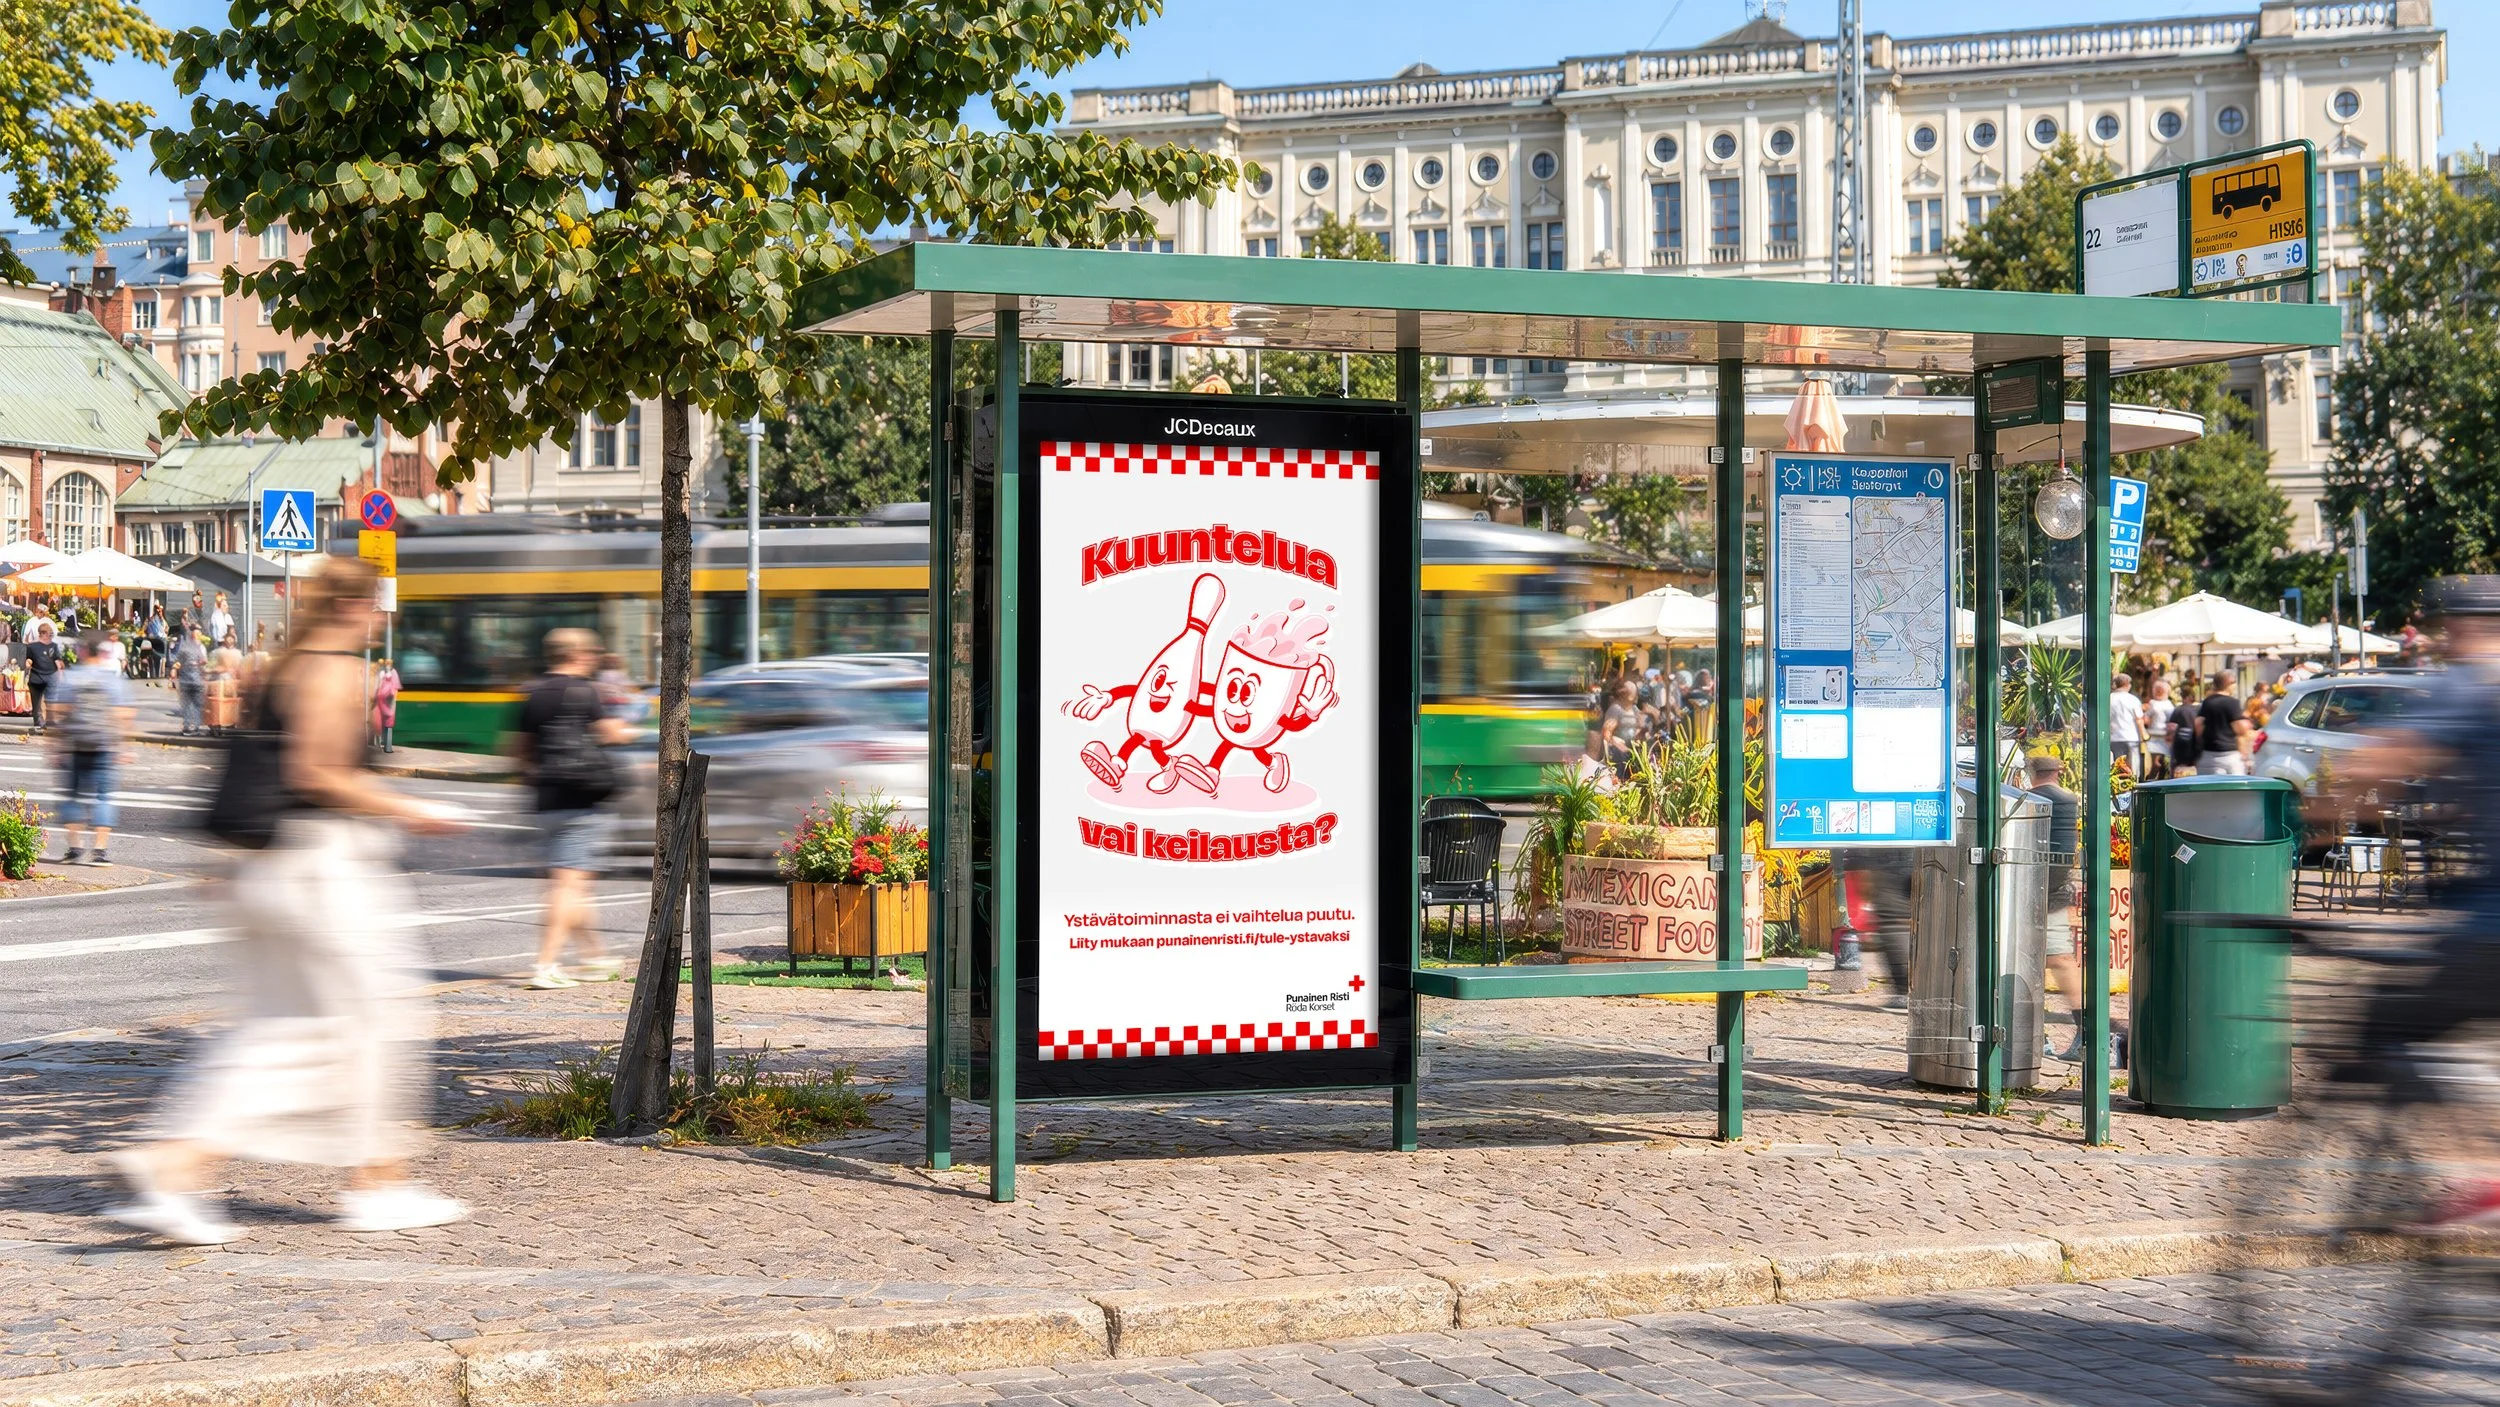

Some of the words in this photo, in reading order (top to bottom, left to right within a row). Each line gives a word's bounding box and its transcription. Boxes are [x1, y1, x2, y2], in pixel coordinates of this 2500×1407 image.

[2085, 227, 2102, 250] 22
[1164, 417, 1256, 438] JCDecaux
[2112, 482, 2140, 518] P
[1081, 523, 1338, 590] Kuuntelua
[1078, 816, 1138, 857] vai
[1143, 812, 1338, 863] keilausta?
[1064, 911, 1212, 927] Ystävätoiminnasta
[1216, 911, 1230, 924] ei
[1233, 909, 1303, 923] vaihtelua
[1306, 908, 1355, 922] puutu.
[1069, 936, 1098, 951] Liity
[1101, 935, 1154, 948] mukaan
[1156, 931, 1350, 949] punainenristi.fi/tule-ystavaksi
[1564, 908, 1649, 952] STREET
[1286, 993, 1328, 1003] Punainen
[1330, 992, 1350, 1001] Risti
[1286, 1003, 1307, 1012] Röda
[1309, 1002, 1335, 1011] Korset
